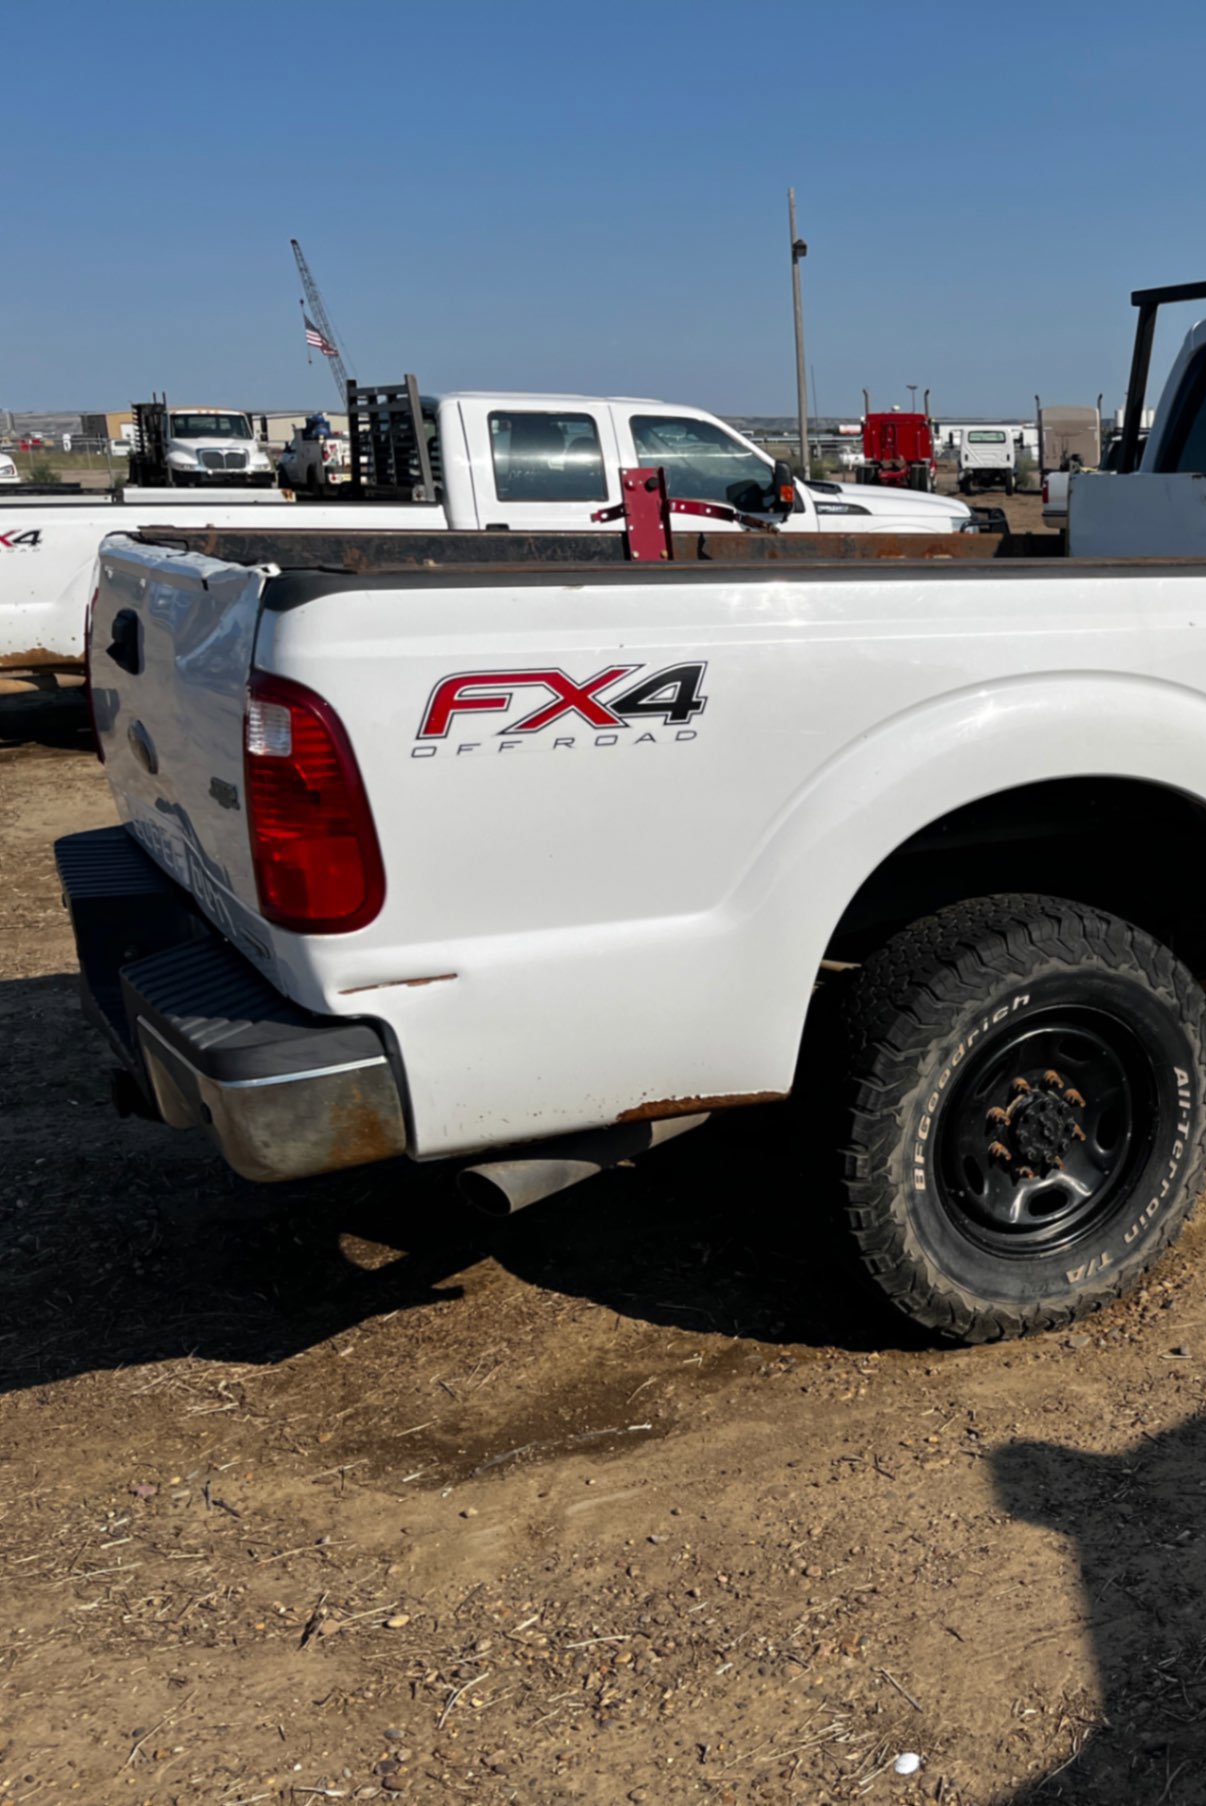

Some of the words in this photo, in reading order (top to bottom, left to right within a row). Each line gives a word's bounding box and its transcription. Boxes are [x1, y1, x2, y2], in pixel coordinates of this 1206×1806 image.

[415, 660, 709, 740] FX4
[410, 739, 524, 759] OFF
[552, 729, 698, 750] ROAD
[914, 993, 1031, 1191] BFGoodrich
[1123, 1066, 1192, 1245] All-Terrain
[1065, 1250, 1115, 1284] T/A
